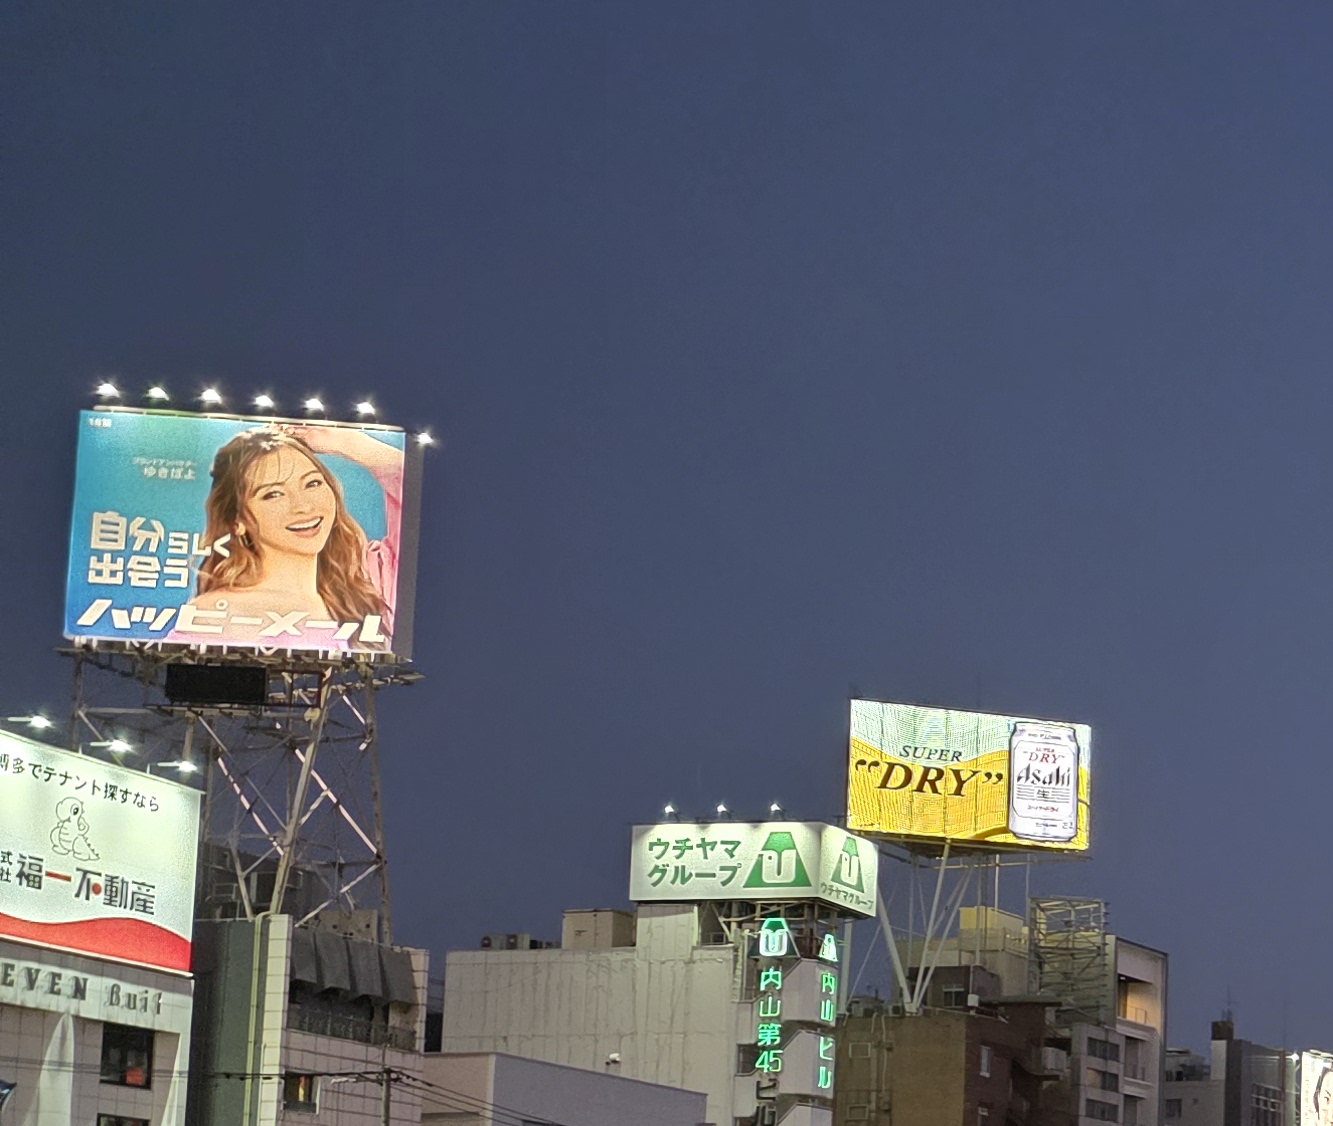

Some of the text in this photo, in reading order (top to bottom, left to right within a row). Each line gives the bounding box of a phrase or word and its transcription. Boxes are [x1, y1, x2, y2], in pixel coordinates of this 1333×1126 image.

[90, 511, 231, 558] 自分らしく
[87, 552, 189, 589] 出会う
[76, 598, 386, 643] ハッピーメール
[900, 745, 963, 763] SUPER
[1017, 763, 1071, 787] Asahi
[648, 837, 742, 860] ウチヤマ
[647, 863, 742, 888] グループ
[820, 882, 874, 910] ウチヤマグループ
